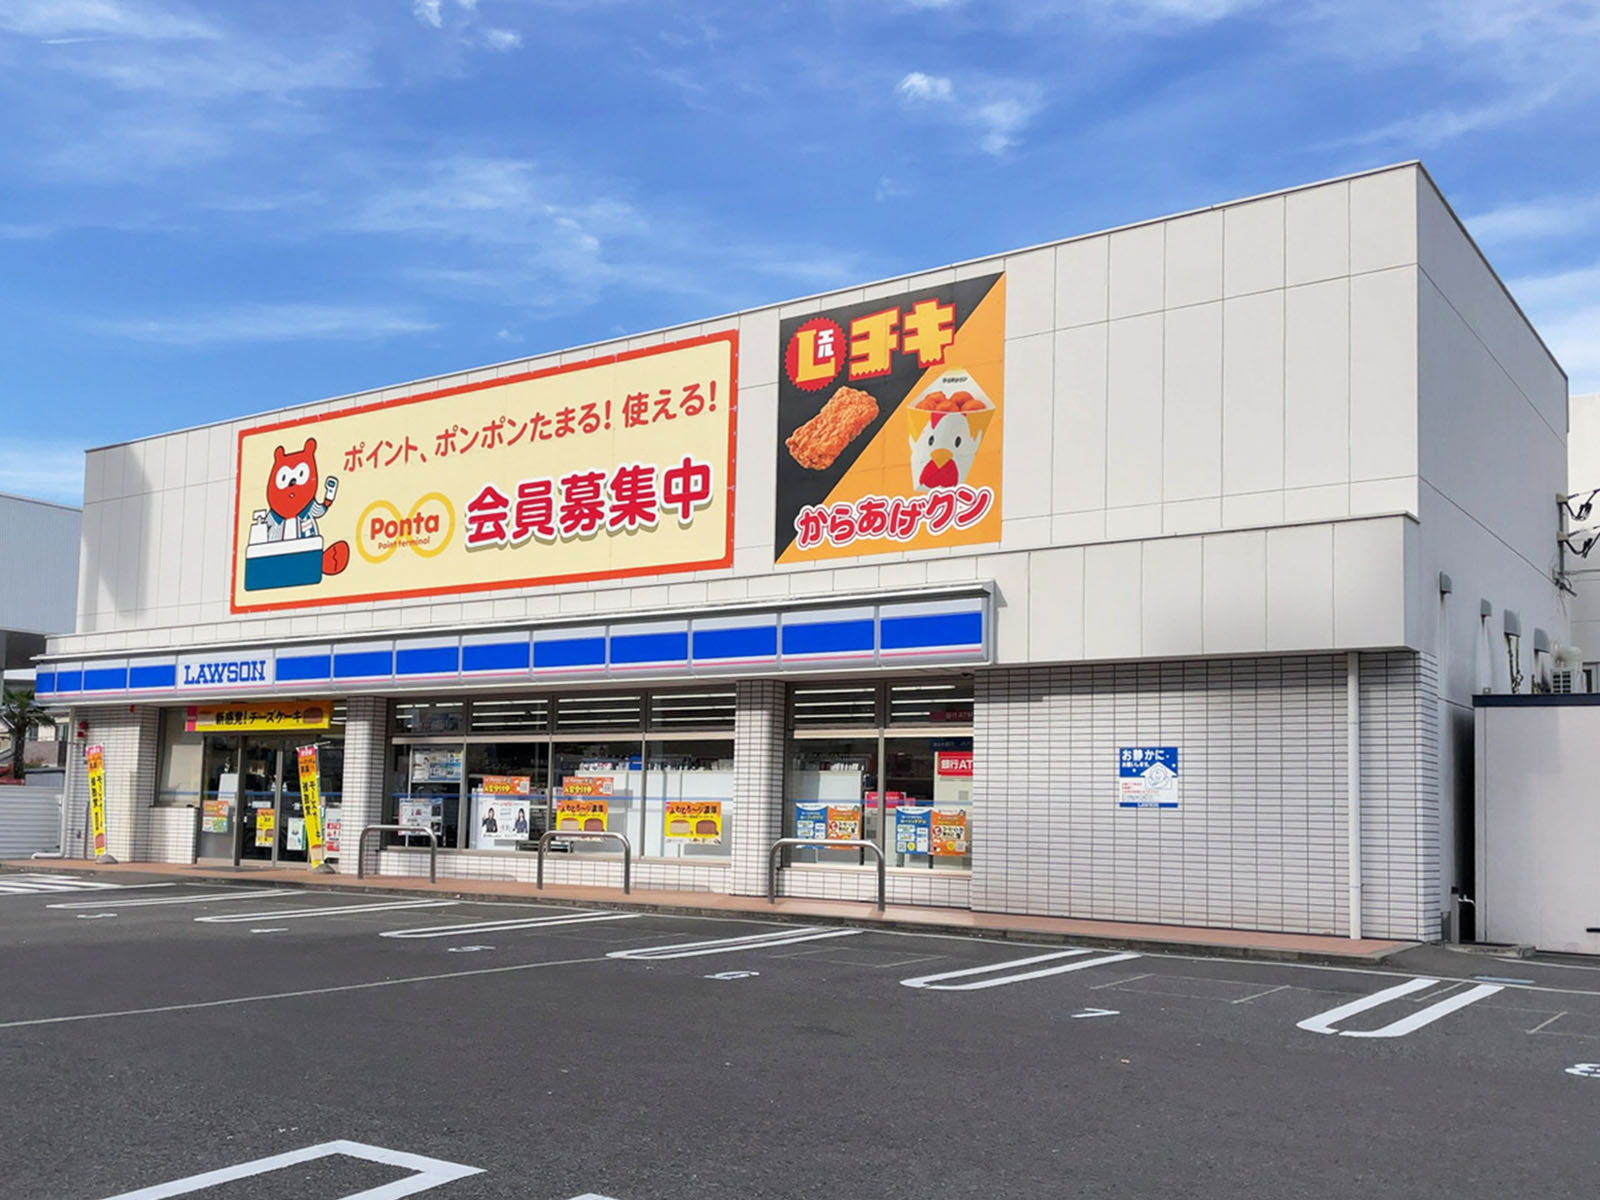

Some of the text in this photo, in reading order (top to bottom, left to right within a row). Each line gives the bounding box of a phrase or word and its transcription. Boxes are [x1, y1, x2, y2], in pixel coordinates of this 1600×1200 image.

[622, 380, 717, 428] 使える!
[466, 456, 712, 545] 会員募集中
[796, 486, 991, 547] からあげクン
[370, 511, 439, 540] Ponta
[184, 660, 266, 685] LAWSON
[1121, 749, 1165, 761] お静かに
